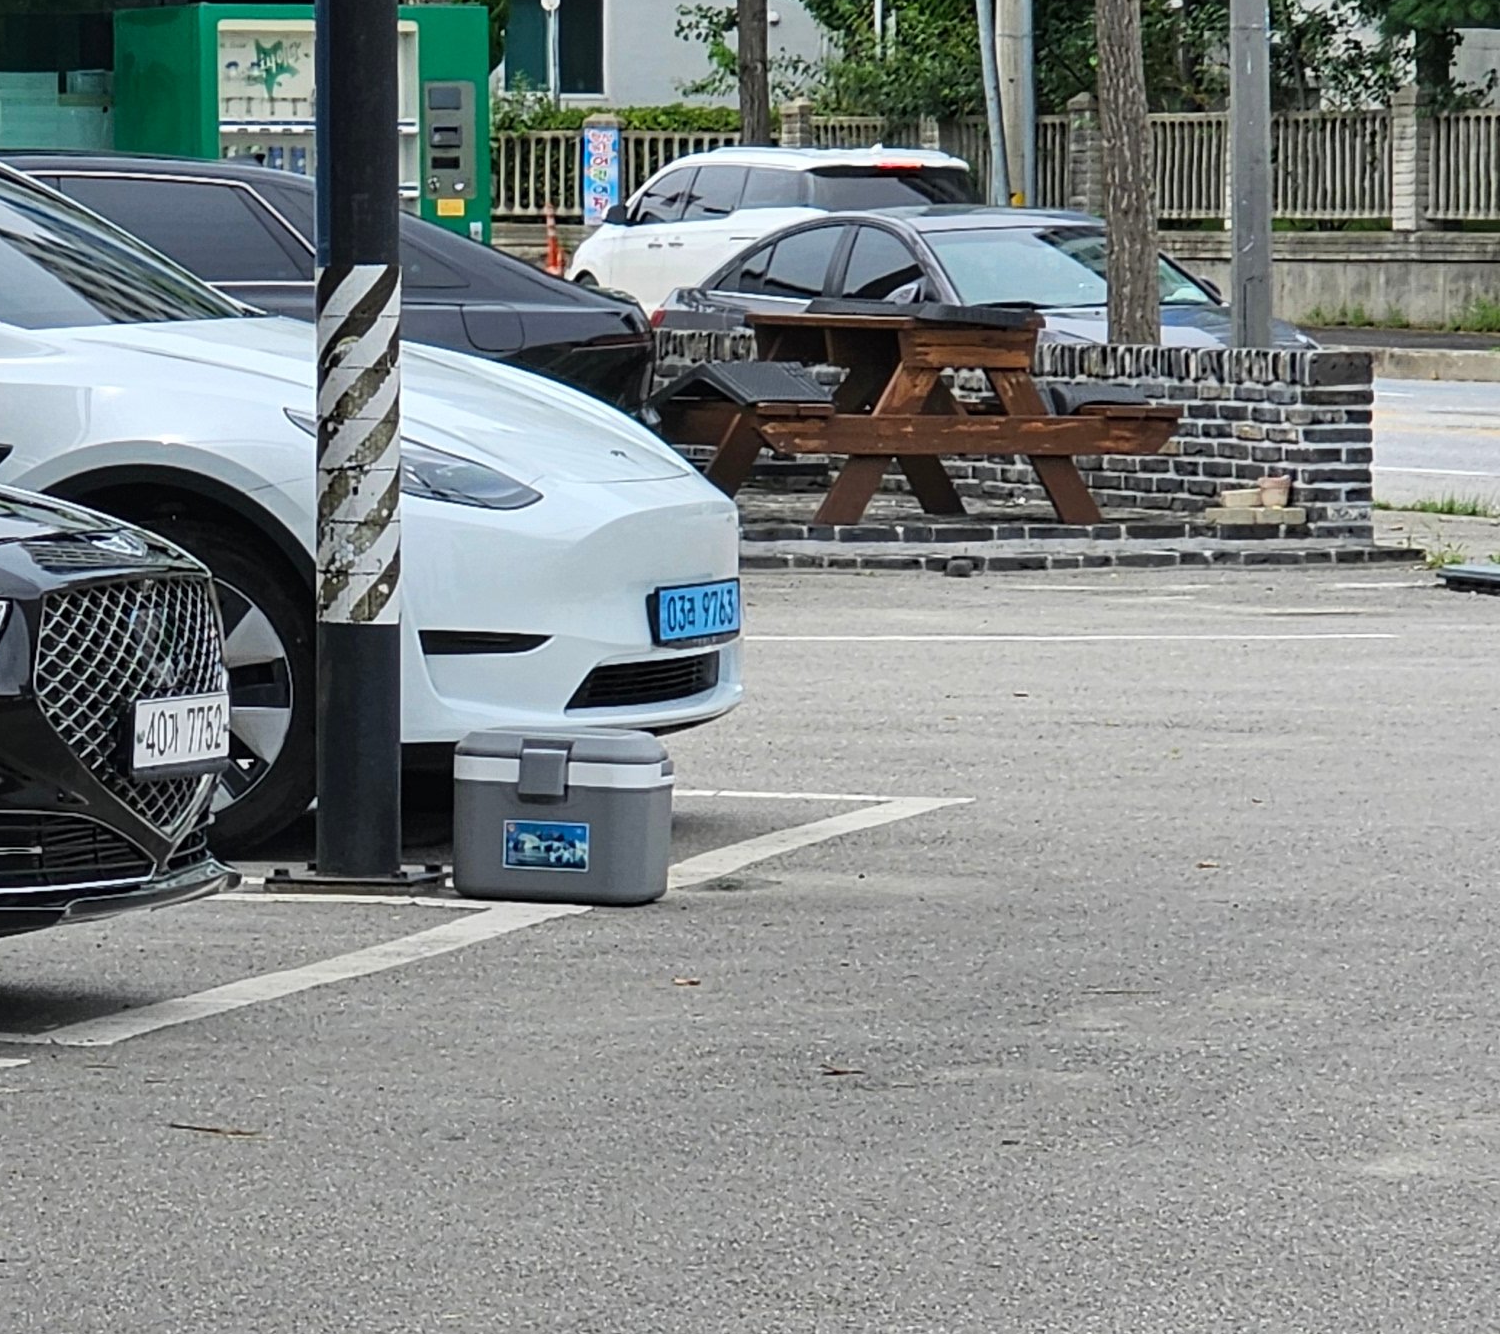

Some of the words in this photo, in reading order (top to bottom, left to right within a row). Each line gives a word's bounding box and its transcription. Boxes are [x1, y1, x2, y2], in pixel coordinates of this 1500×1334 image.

[666, 594, 696, 633] 03라
[702, 588, 735, 628] 9763
[145, 709, 179, 759] 40가
[186, 703, 223, 754] 7752
